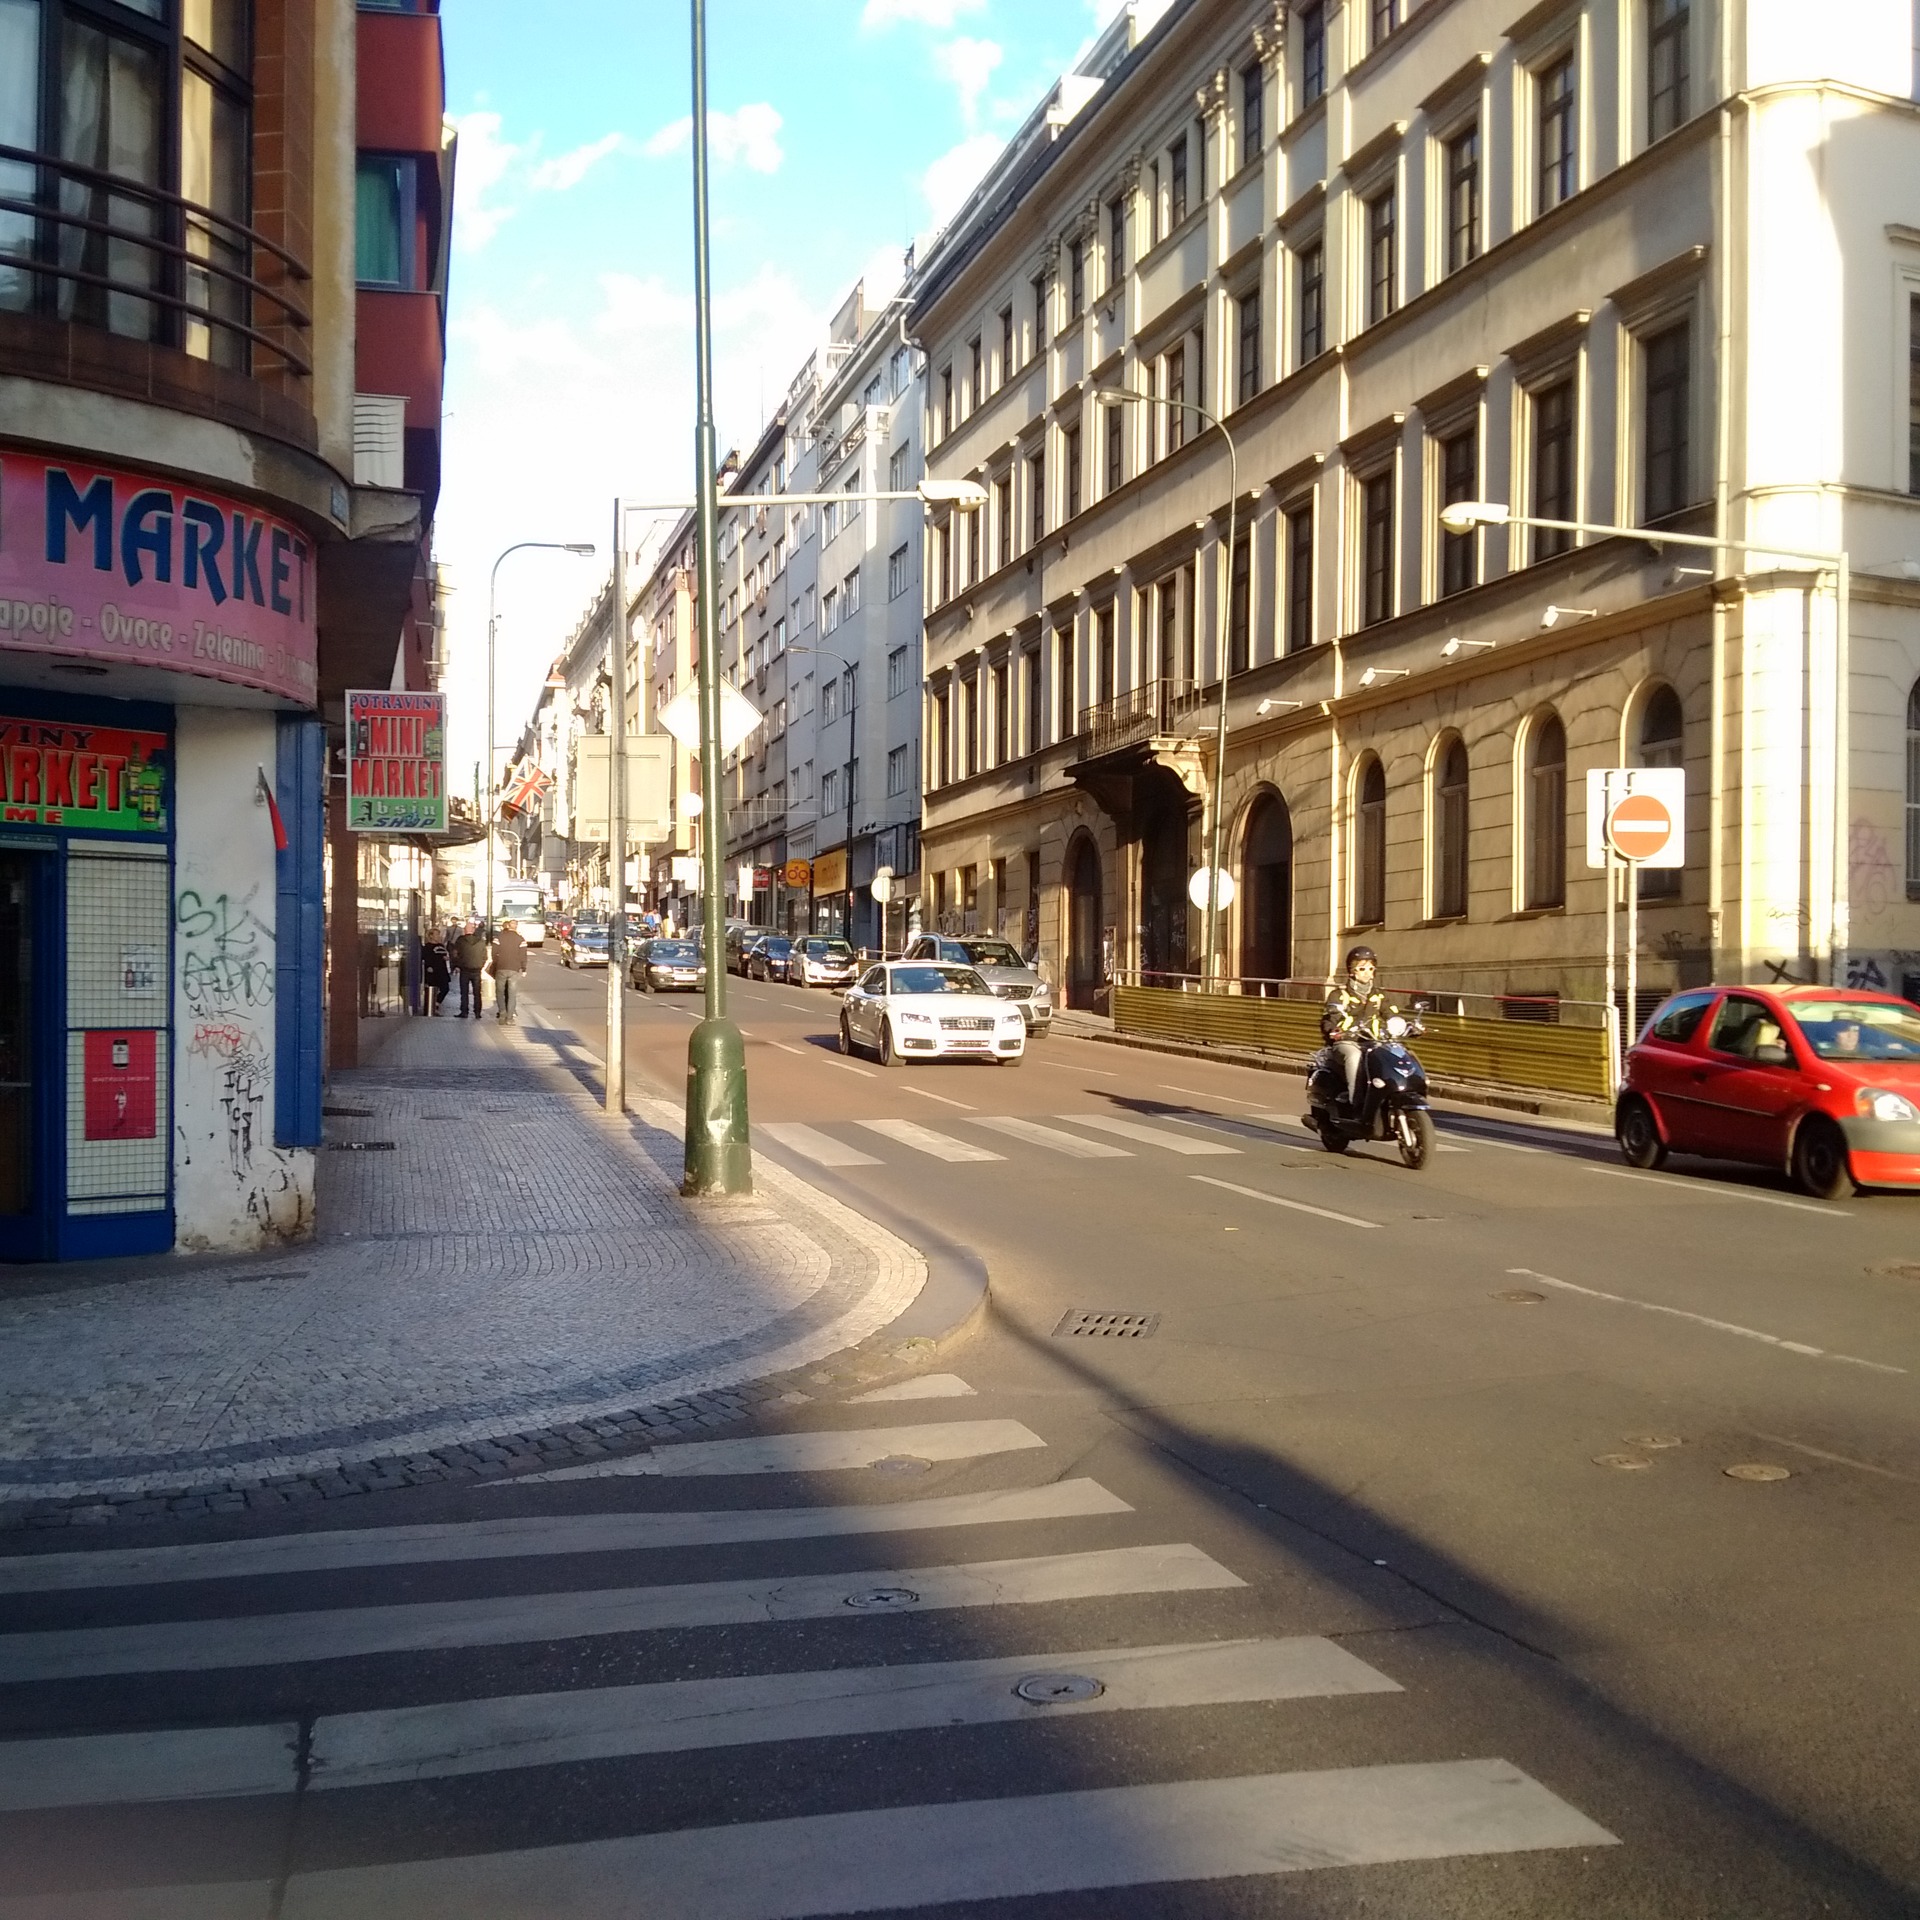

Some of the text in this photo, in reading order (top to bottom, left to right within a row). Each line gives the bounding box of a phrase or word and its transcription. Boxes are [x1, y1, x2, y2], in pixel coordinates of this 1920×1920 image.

[45, 466, 308, 623] MARKET
[100, 602, 173, 652] Ovoce
[193, 619, 266, 673] Zelenina
[350, 695, 442, 710] POTRAVINY
[369, 716, 423, 757] MINI
[351, 758, 442, 799] MARKET
